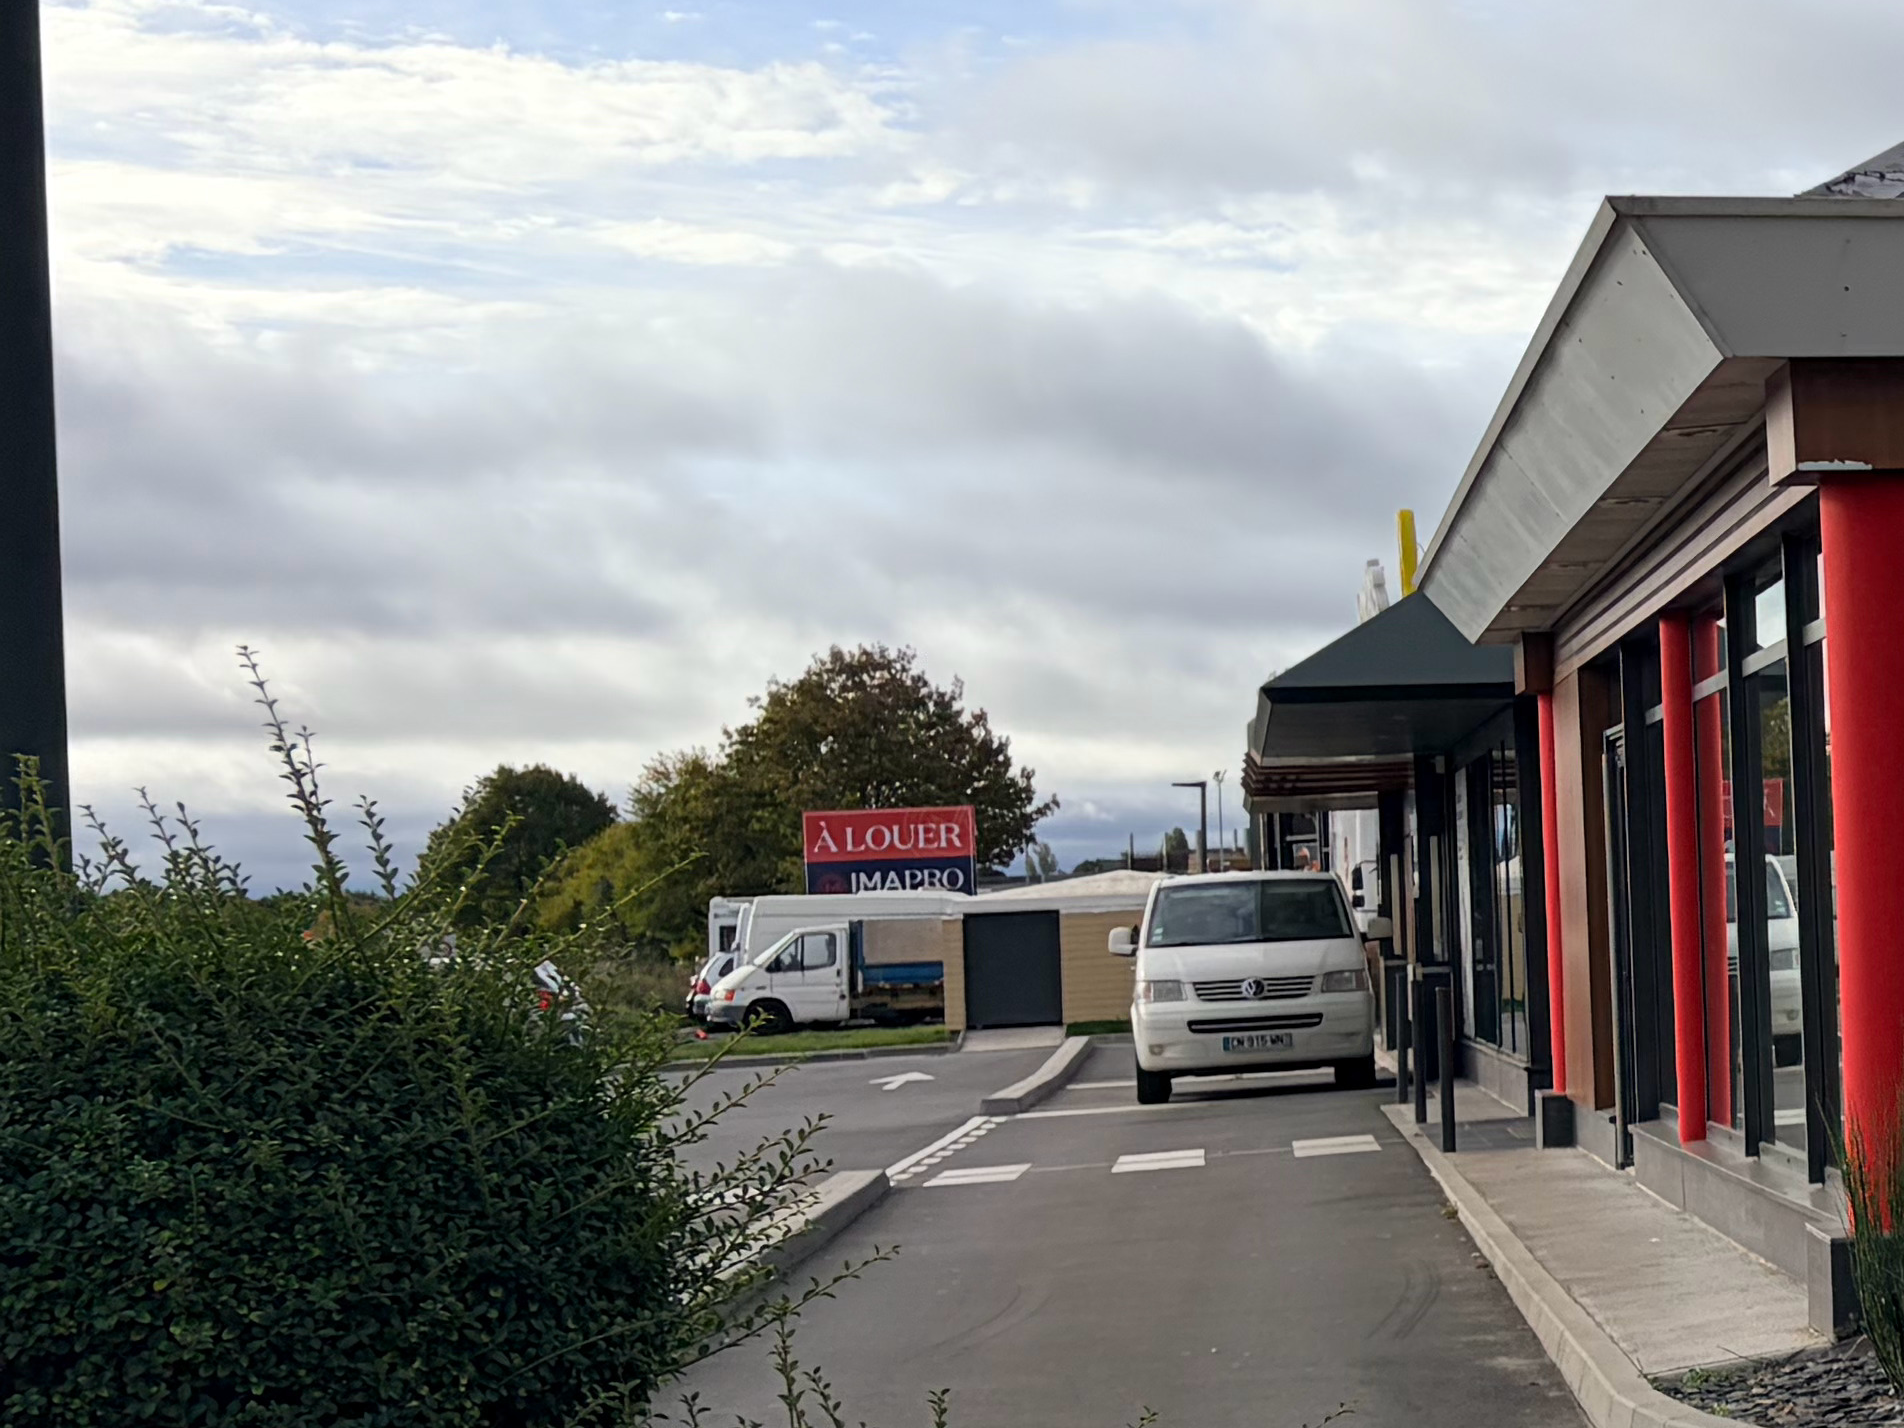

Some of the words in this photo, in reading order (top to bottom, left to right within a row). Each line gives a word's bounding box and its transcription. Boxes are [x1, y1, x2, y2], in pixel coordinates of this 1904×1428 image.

[813, 820, 839, 854] À
[845, 822, 963, 853] LOUER
[851, 867, 965, 895] IMAPRO
